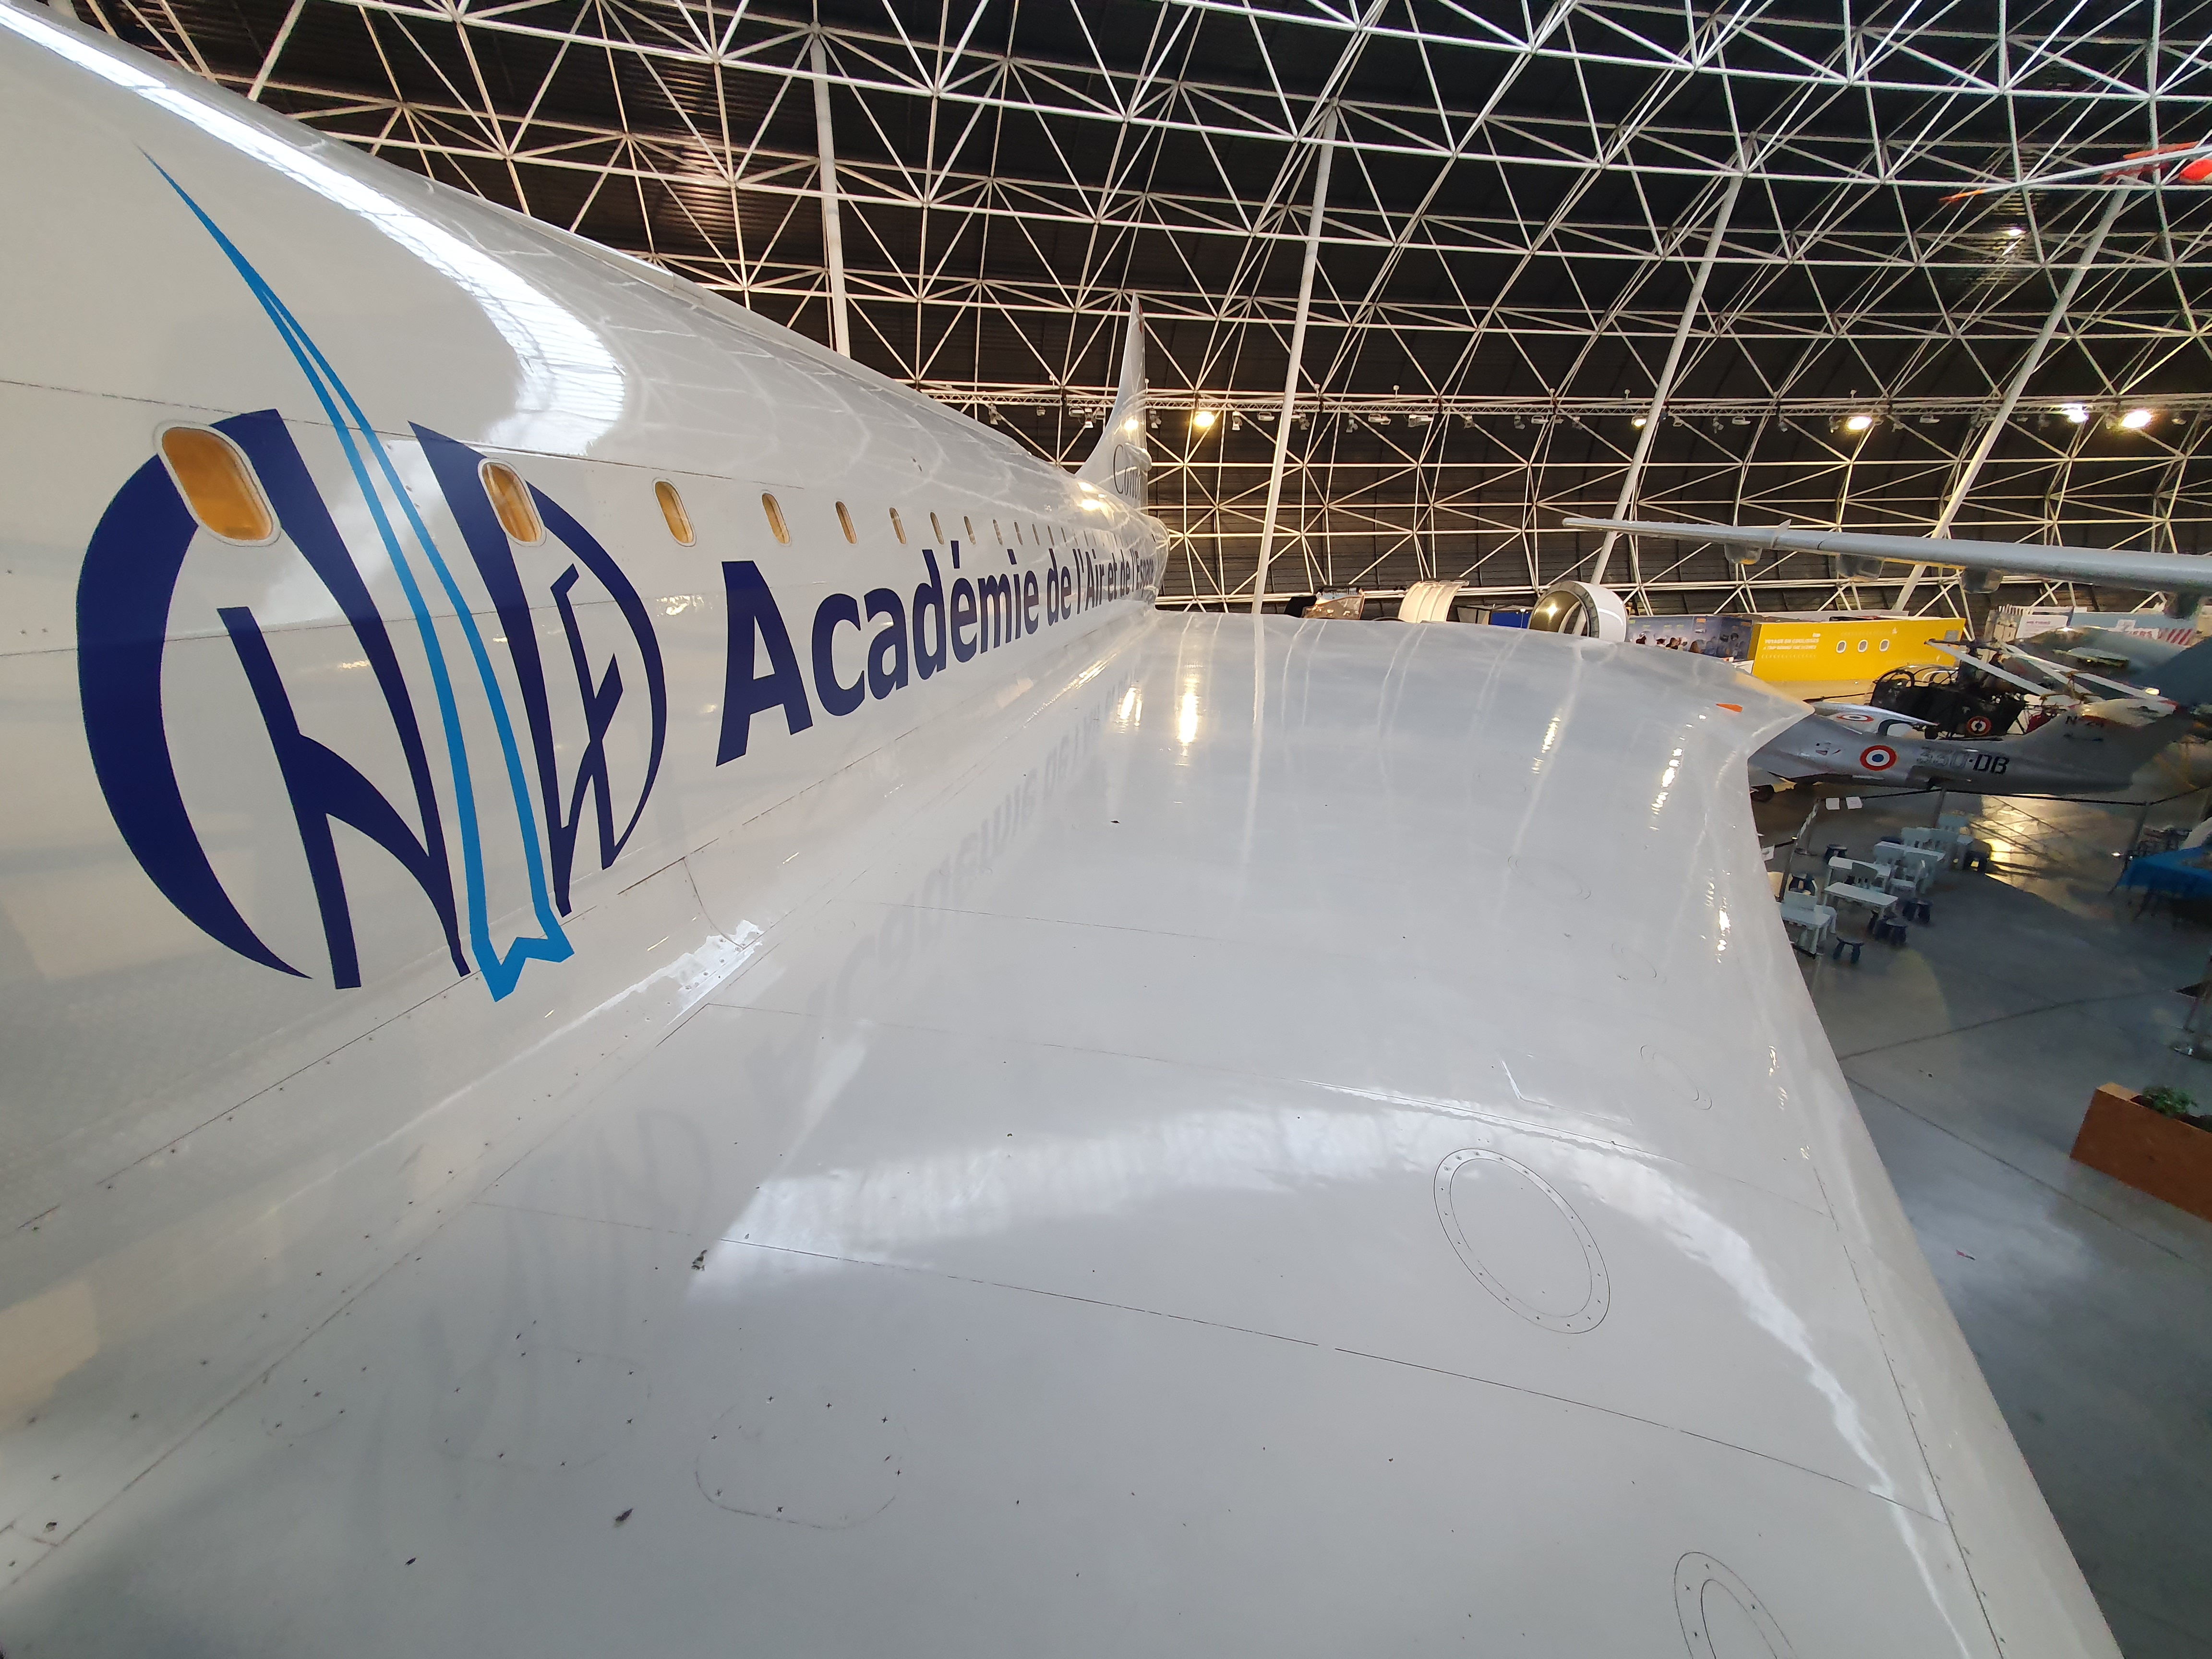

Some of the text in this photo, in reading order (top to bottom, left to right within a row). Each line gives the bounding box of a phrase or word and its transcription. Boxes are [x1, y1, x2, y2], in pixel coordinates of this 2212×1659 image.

[716, 540, 1039, 767] Académie
[1047, 548, 1071, 626] de
[1072, 548, 1105, 614] l'Air
[1107, 553, 1118, 602] et
[1120, 549, 1130, 598] de
